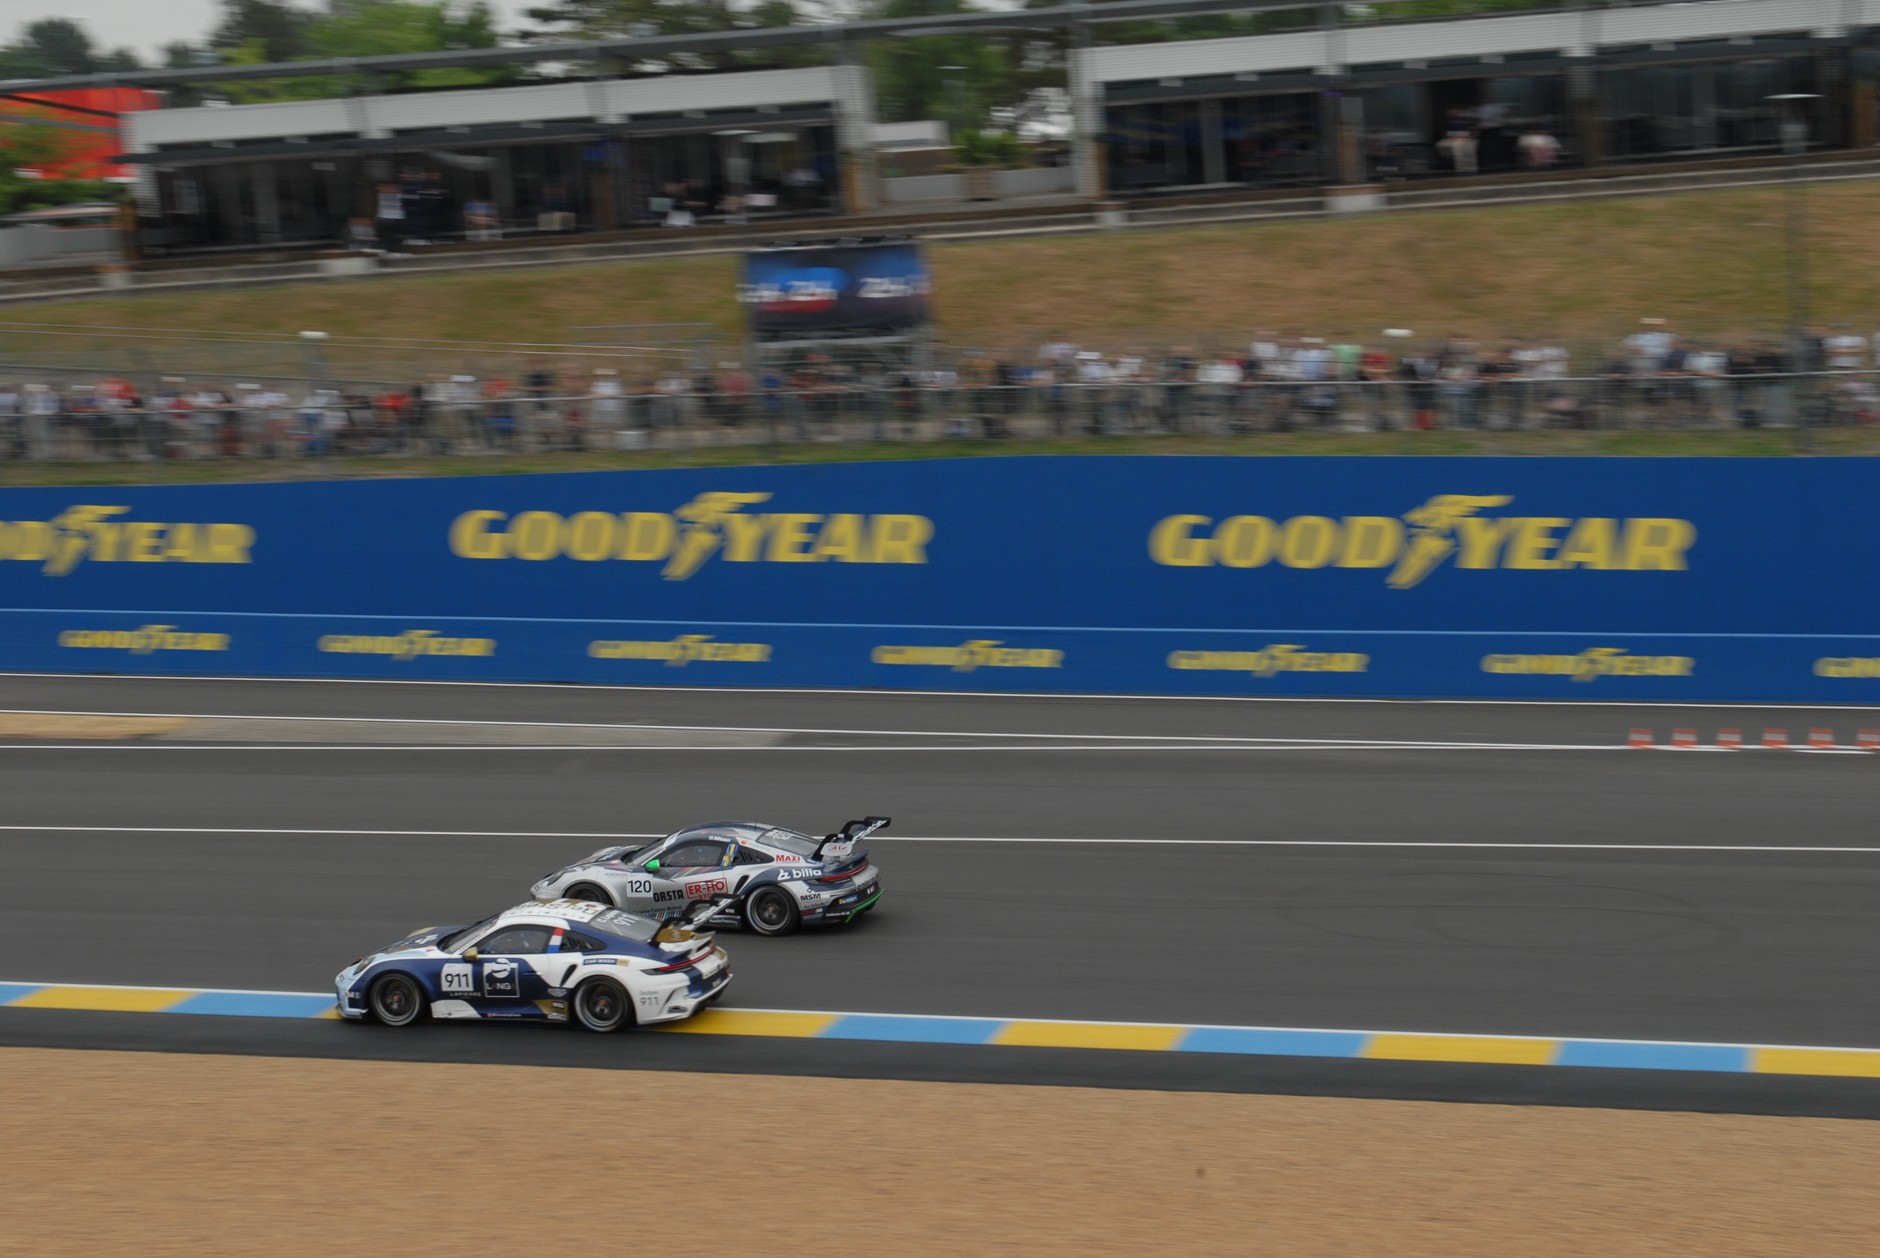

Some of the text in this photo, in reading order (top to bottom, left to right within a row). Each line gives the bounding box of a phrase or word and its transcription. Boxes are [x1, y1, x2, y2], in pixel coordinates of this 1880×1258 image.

[449, 508, 934, 564] GOODYEAR
[1150, 512, 1695, 571] GOODYEAR
[627, 880, 652, 893] 120
[688, 881, 725, 895] ER-HO
[800, 893, 821, 901] MSM
[444, 973, 470, 988] 911
[640, 996, 659, 1006] 911
